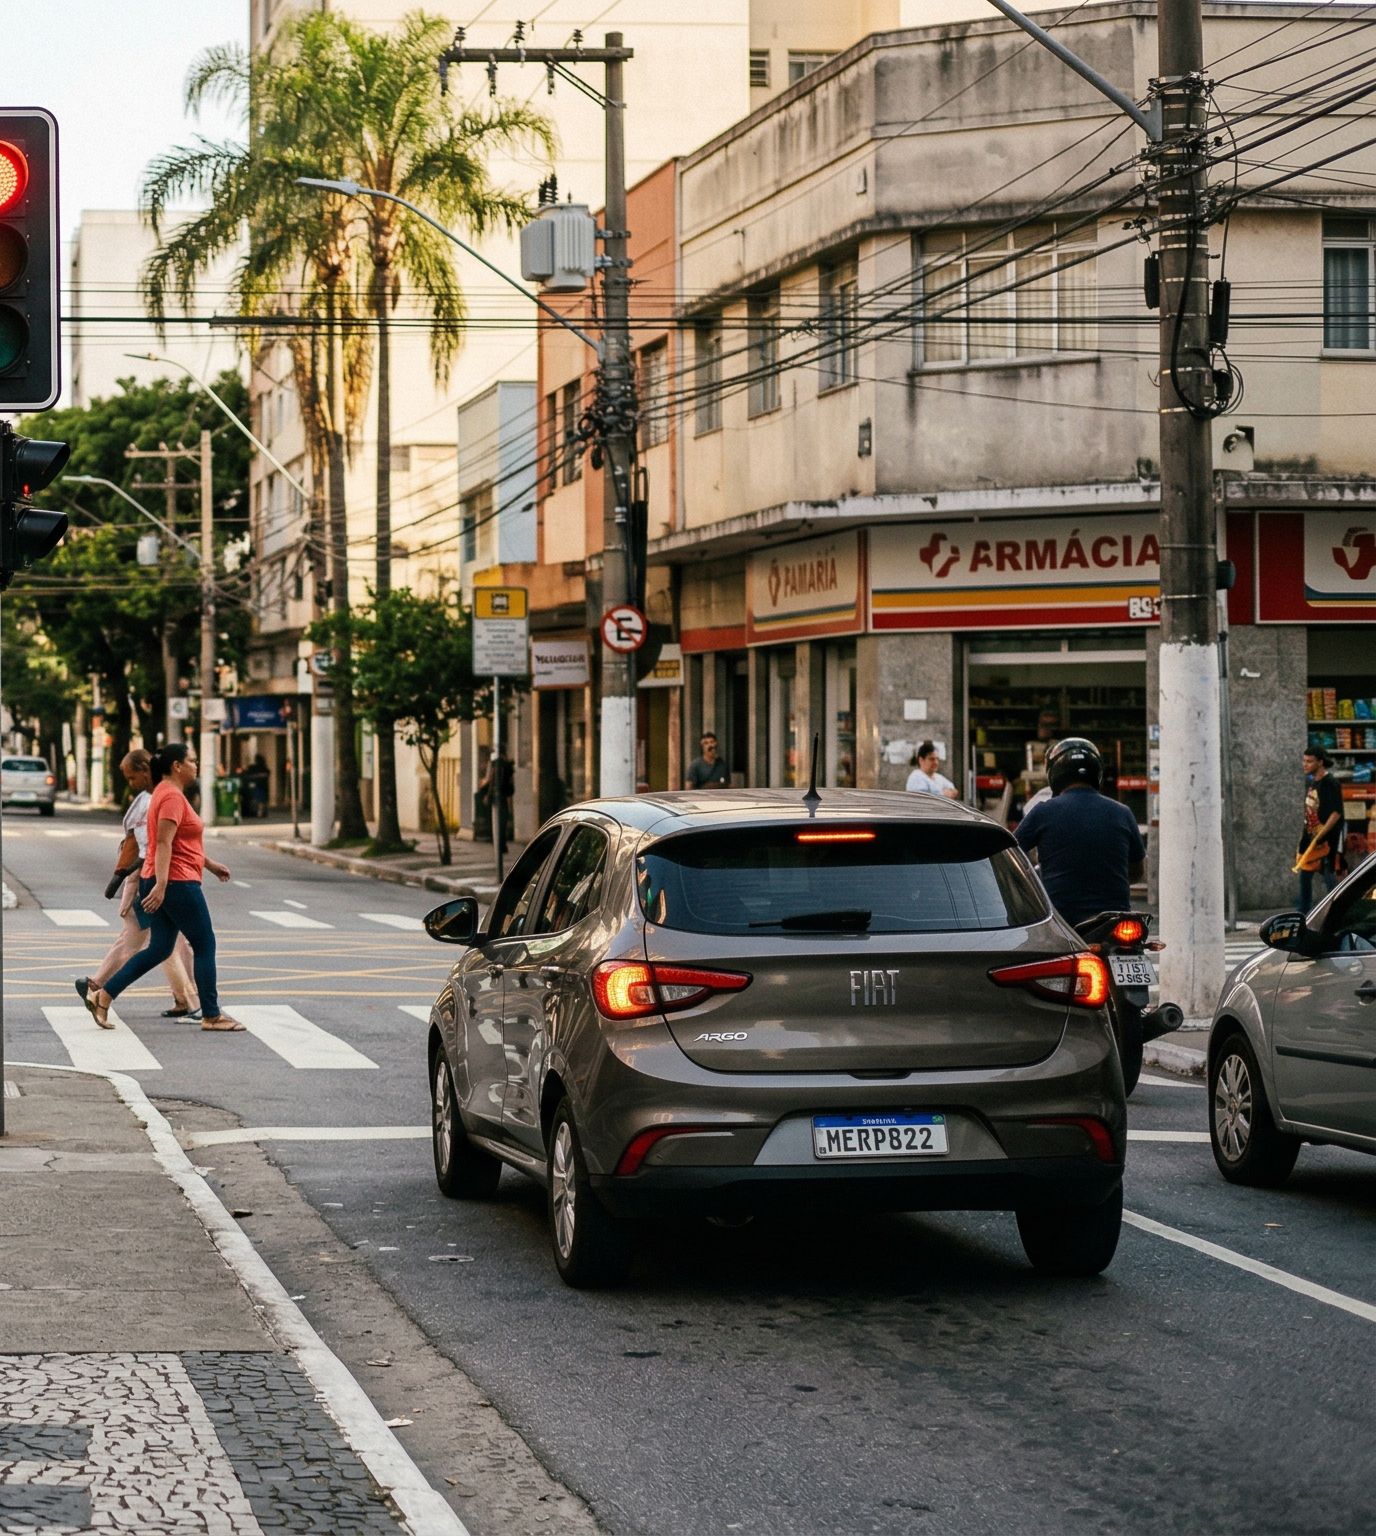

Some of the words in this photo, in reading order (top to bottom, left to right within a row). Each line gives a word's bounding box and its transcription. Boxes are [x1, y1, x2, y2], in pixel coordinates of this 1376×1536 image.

[849, 970, 900, 1006] FIAT
[693, 1031, 748, 1043] ARGO
[826, 1127, 934, 1153] MERP822
